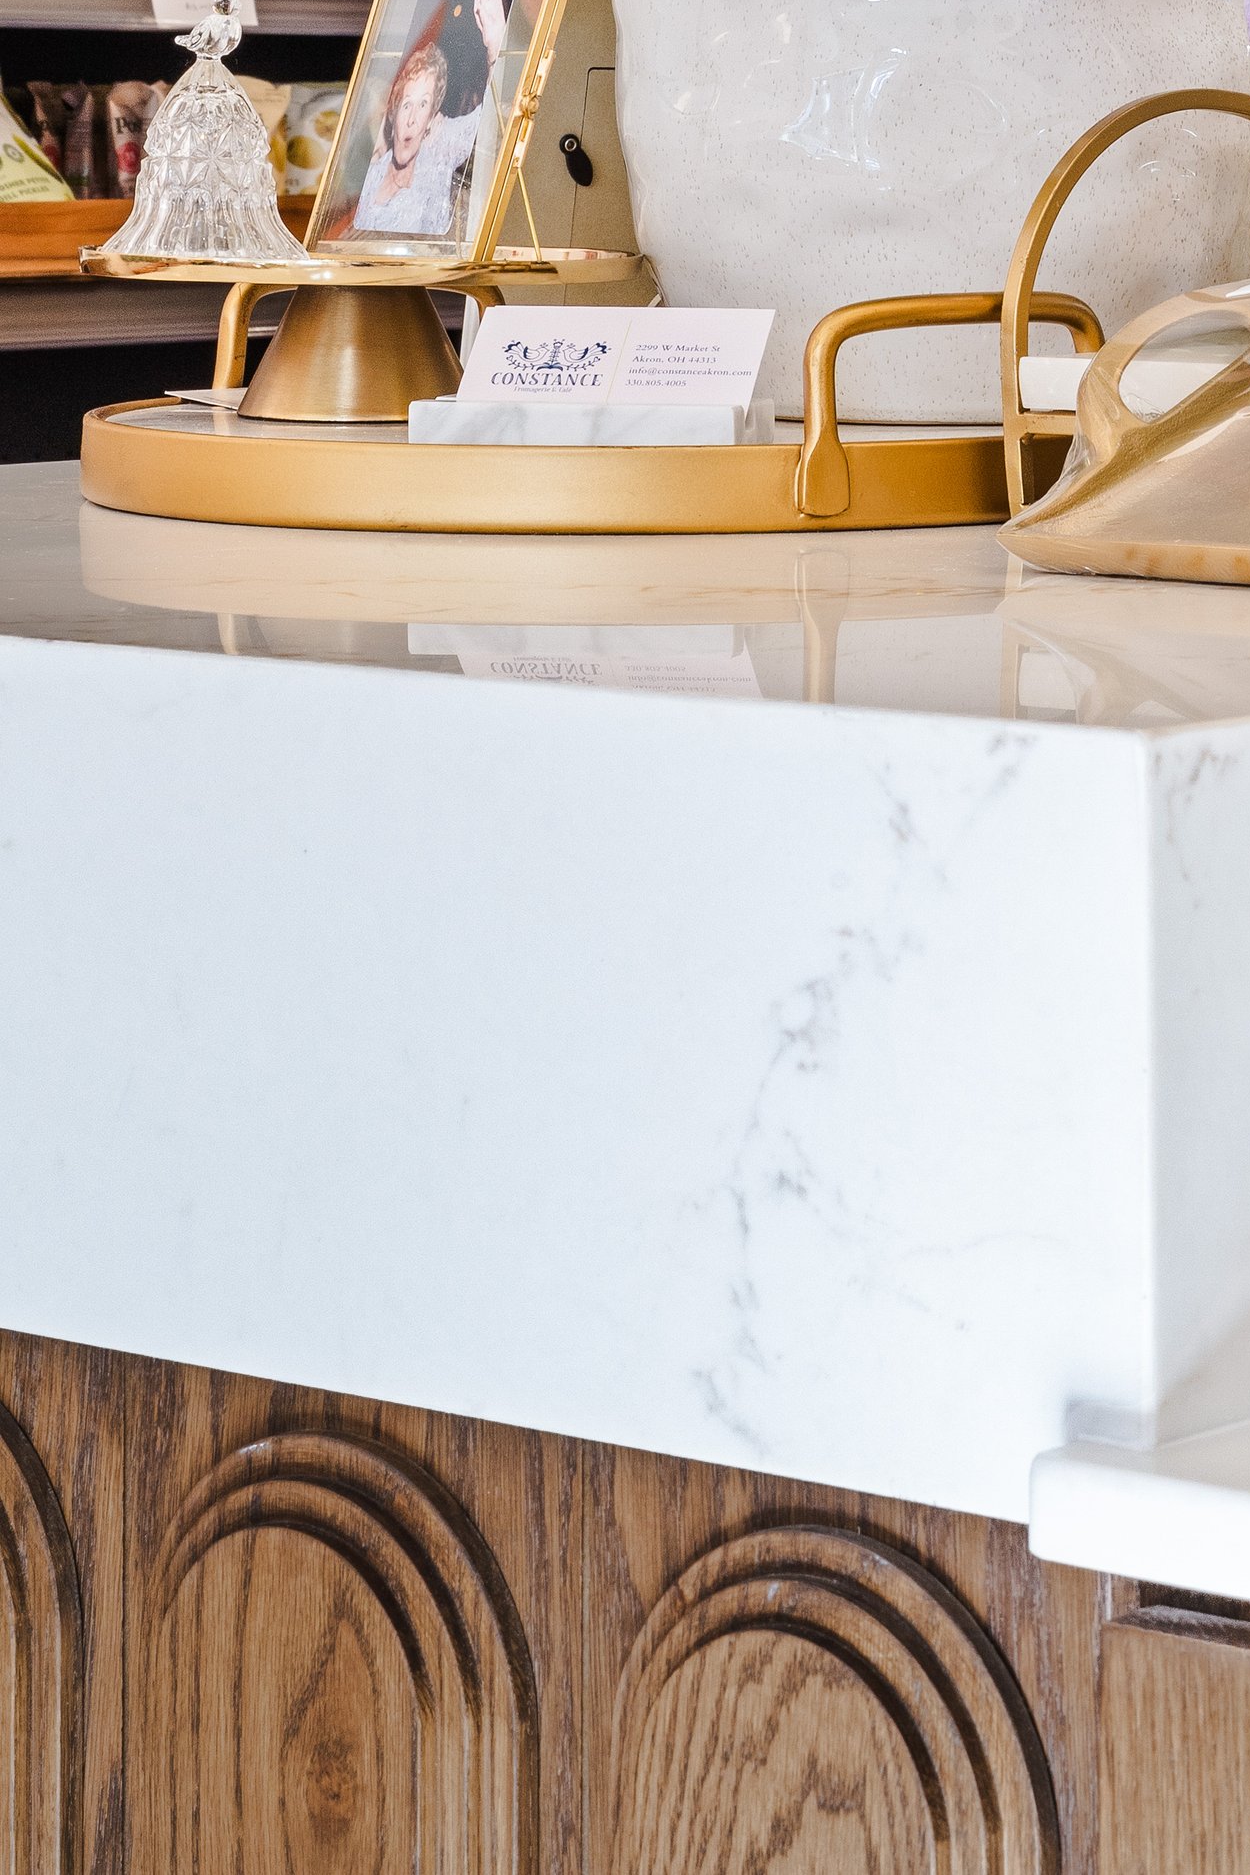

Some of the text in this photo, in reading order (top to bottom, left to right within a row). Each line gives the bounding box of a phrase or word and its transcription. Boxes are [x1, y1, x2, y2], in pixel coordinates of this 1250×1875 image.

[675, 344, 709, 352] Market
[710, 344, 720, 352] St
[632, 355, 717, 364] Akron, OH 44313
[628, 367, 753, 377] info@constanceakron.com
[490, 371, 604, 387] CONSTANCE
[625, 379, 687, 387] 330.805.4005
